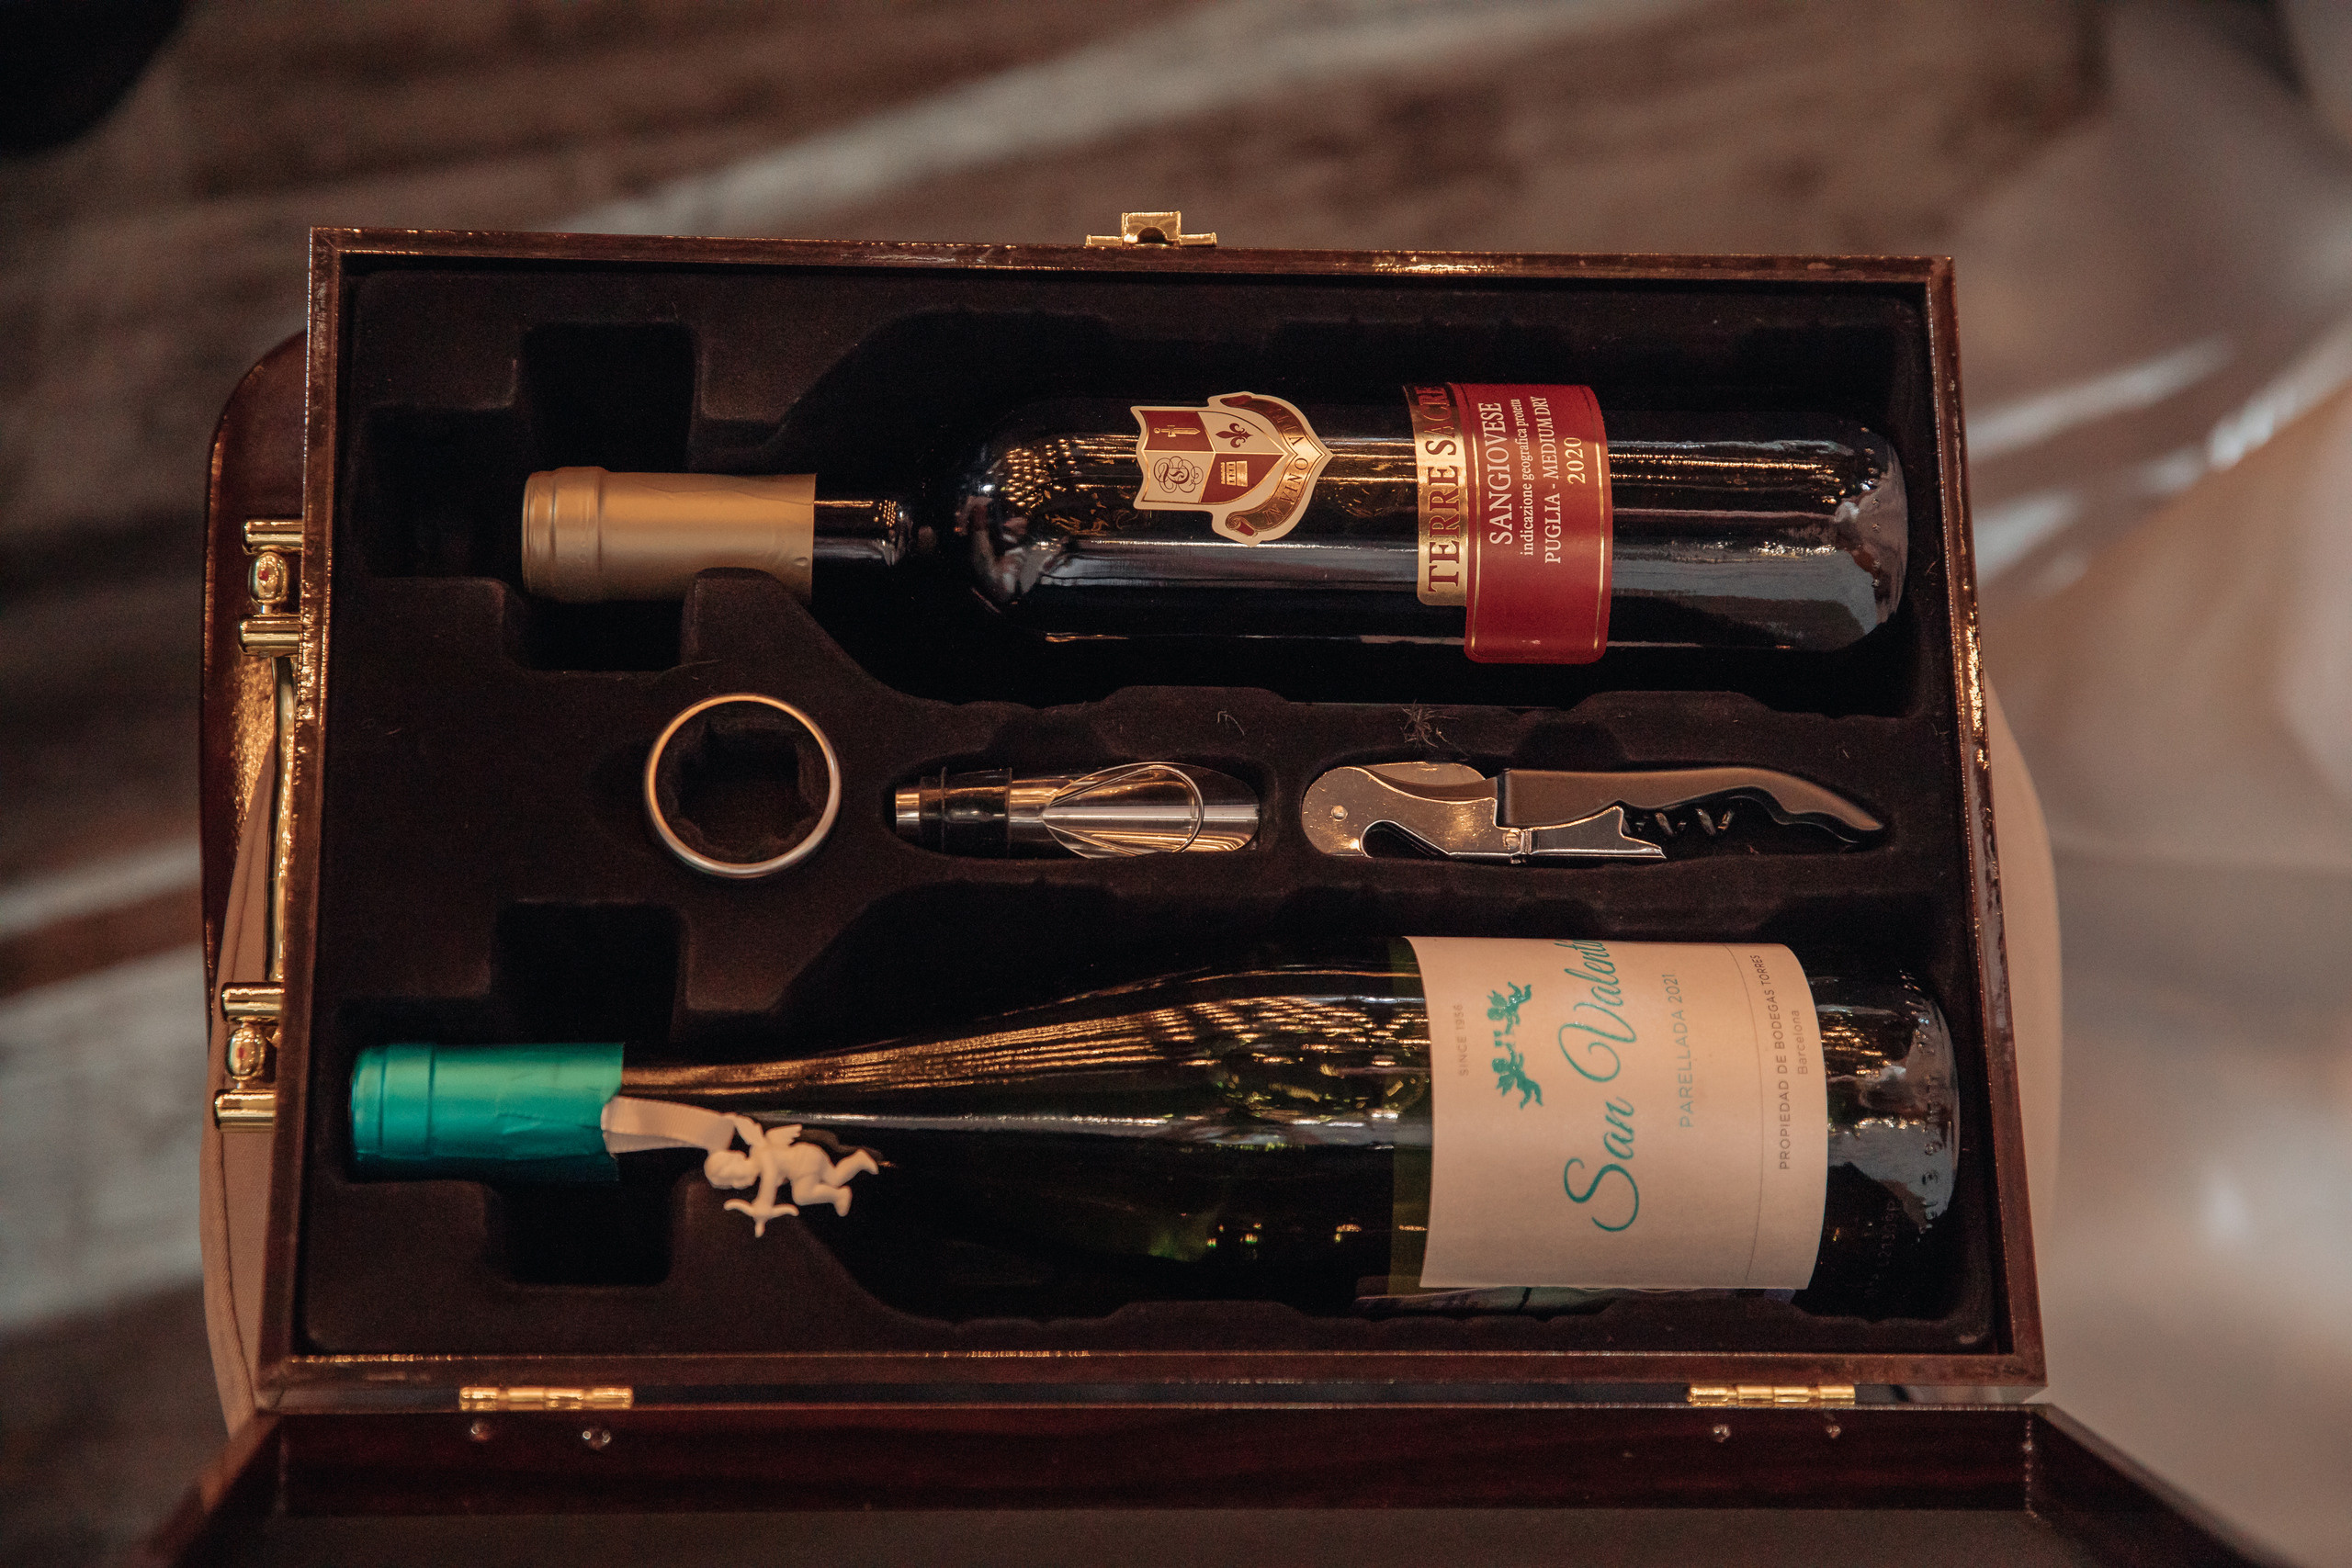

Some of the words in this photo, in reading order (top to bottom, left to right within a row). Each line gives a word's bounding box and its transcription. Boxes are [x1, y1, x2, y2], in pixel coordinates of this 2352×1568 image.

[1510, 399, 1529, 428] protetta
[1530, 396, 1552, 416] DRY
[1477, 402, 1513, 545] SANGIOVESE
[1515, 428, 1535, 482] geografica
[1537, 416, 1560, 479] MEDIUM
[1564, 437, 1586, 485] 2020
[1262, 506, 1283, 525] IN
[1280, 457, 1309, 504] VINO
[1520, 483, 1534, 557] indicazione
[1427, 466, 1460, 592] TERRE
[1544, 493, 1562, 563] PUGLIA
[1661, 974, 1683, 1004] 2021
[1749, 954, 1771, 986] TORRES
[1764, 989, 1786, 1050] BODEGAS
[1792, 1010, 1808, 1076] Barcelona
[1456, 1035, 1470, 1077] SINCE
[1671, 1010, 1694, 1128] PARELLADA
[1776, 1055, 1788, 1076] DE
[1778, 1079, 1791, 1170] PROPIEDAD
[1564, 1096, 1640, 1233] San
